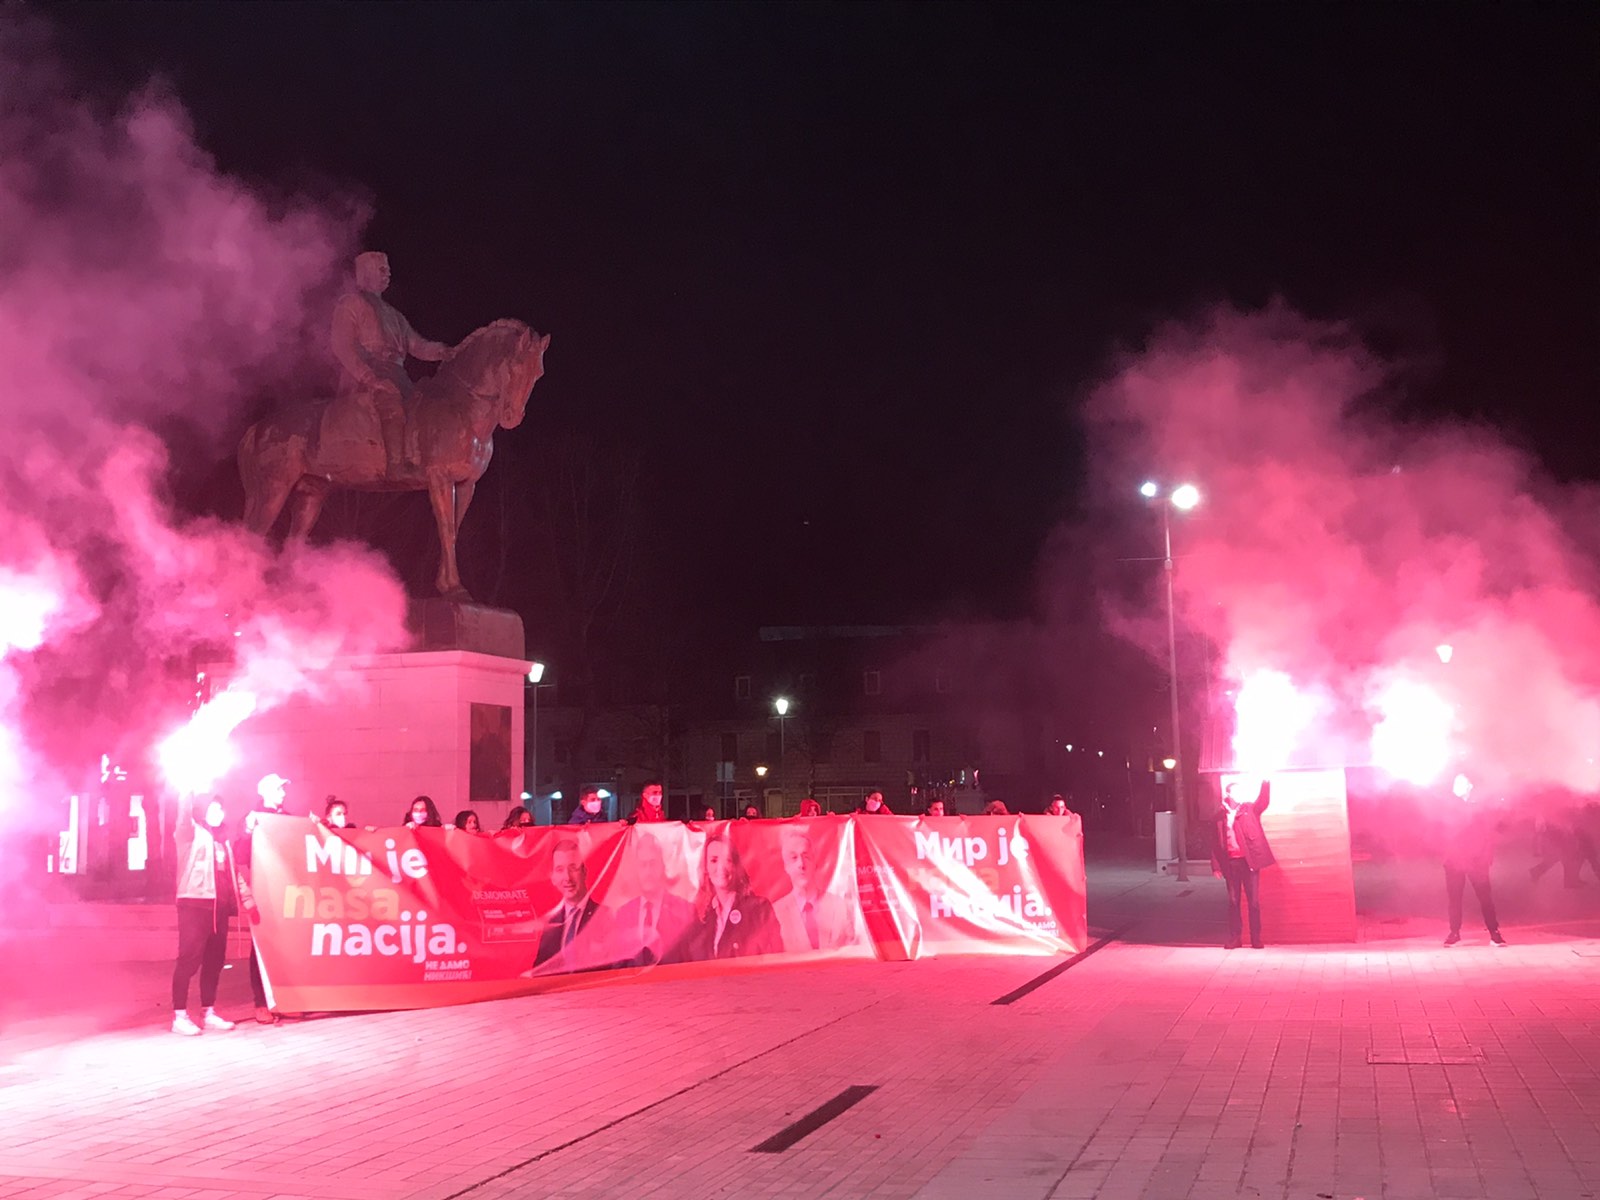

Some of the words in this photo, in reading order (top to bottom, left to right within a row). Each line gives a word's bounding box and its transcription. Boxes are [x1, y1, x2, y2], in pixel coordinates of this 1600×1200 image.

[385, 838, 429, 883] je
[914, 831, 987, 867] Мир
[283, 876, 399, 920] naša
[473, 889, 529, 900] DEMOKRATE
[311, 910, 467, 963] nacija.
